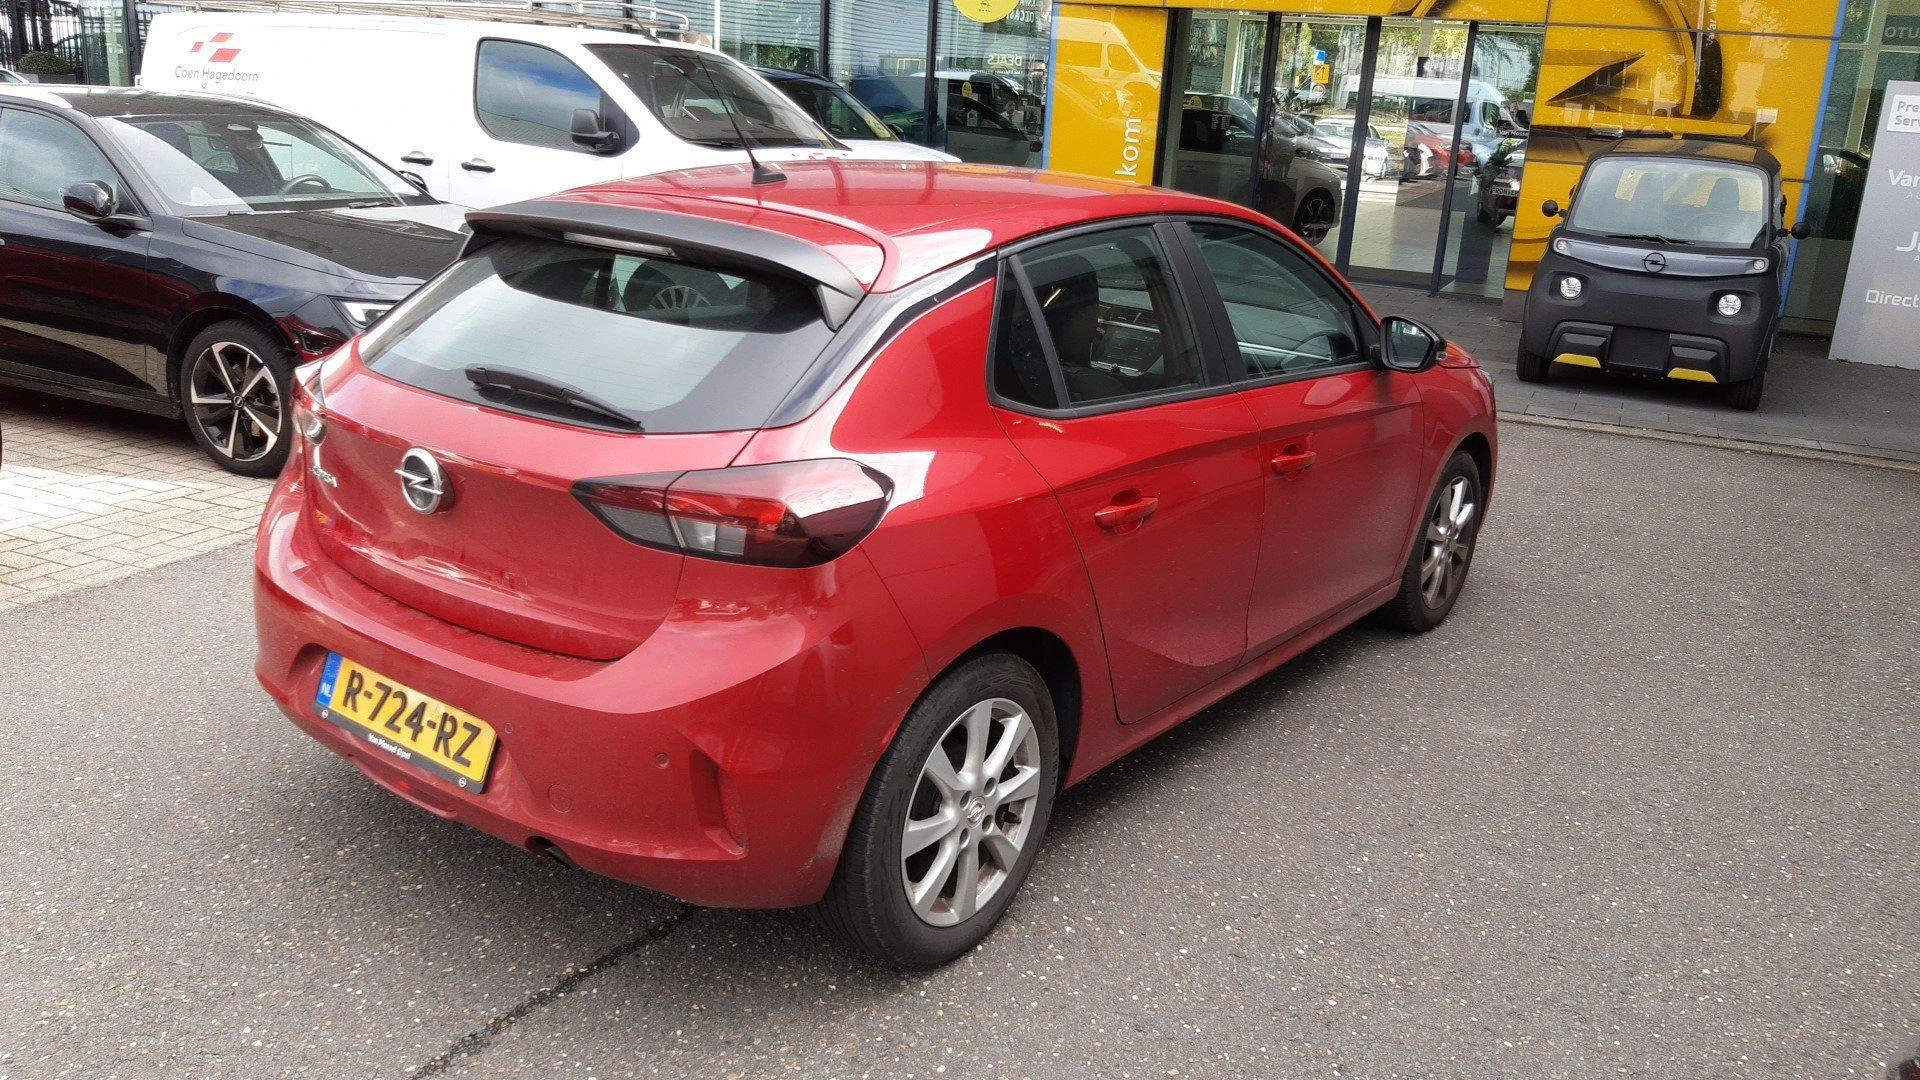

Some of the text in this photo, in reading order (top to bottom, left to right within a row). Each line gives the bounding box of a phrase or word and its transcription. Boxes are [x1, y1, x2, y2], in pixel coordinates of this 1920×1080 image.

[174, 65, 259, 84] Coen Hagedoorn
[1114, 118, 1142, 183] kom
[1896, 231, 1920, 252] J
[322, 682, 331, 698] NL
[341, 669, 482, 768] R-724-RZ
[368, 733, 379, 745] Van
[397, 747, 411, 760] Opel
